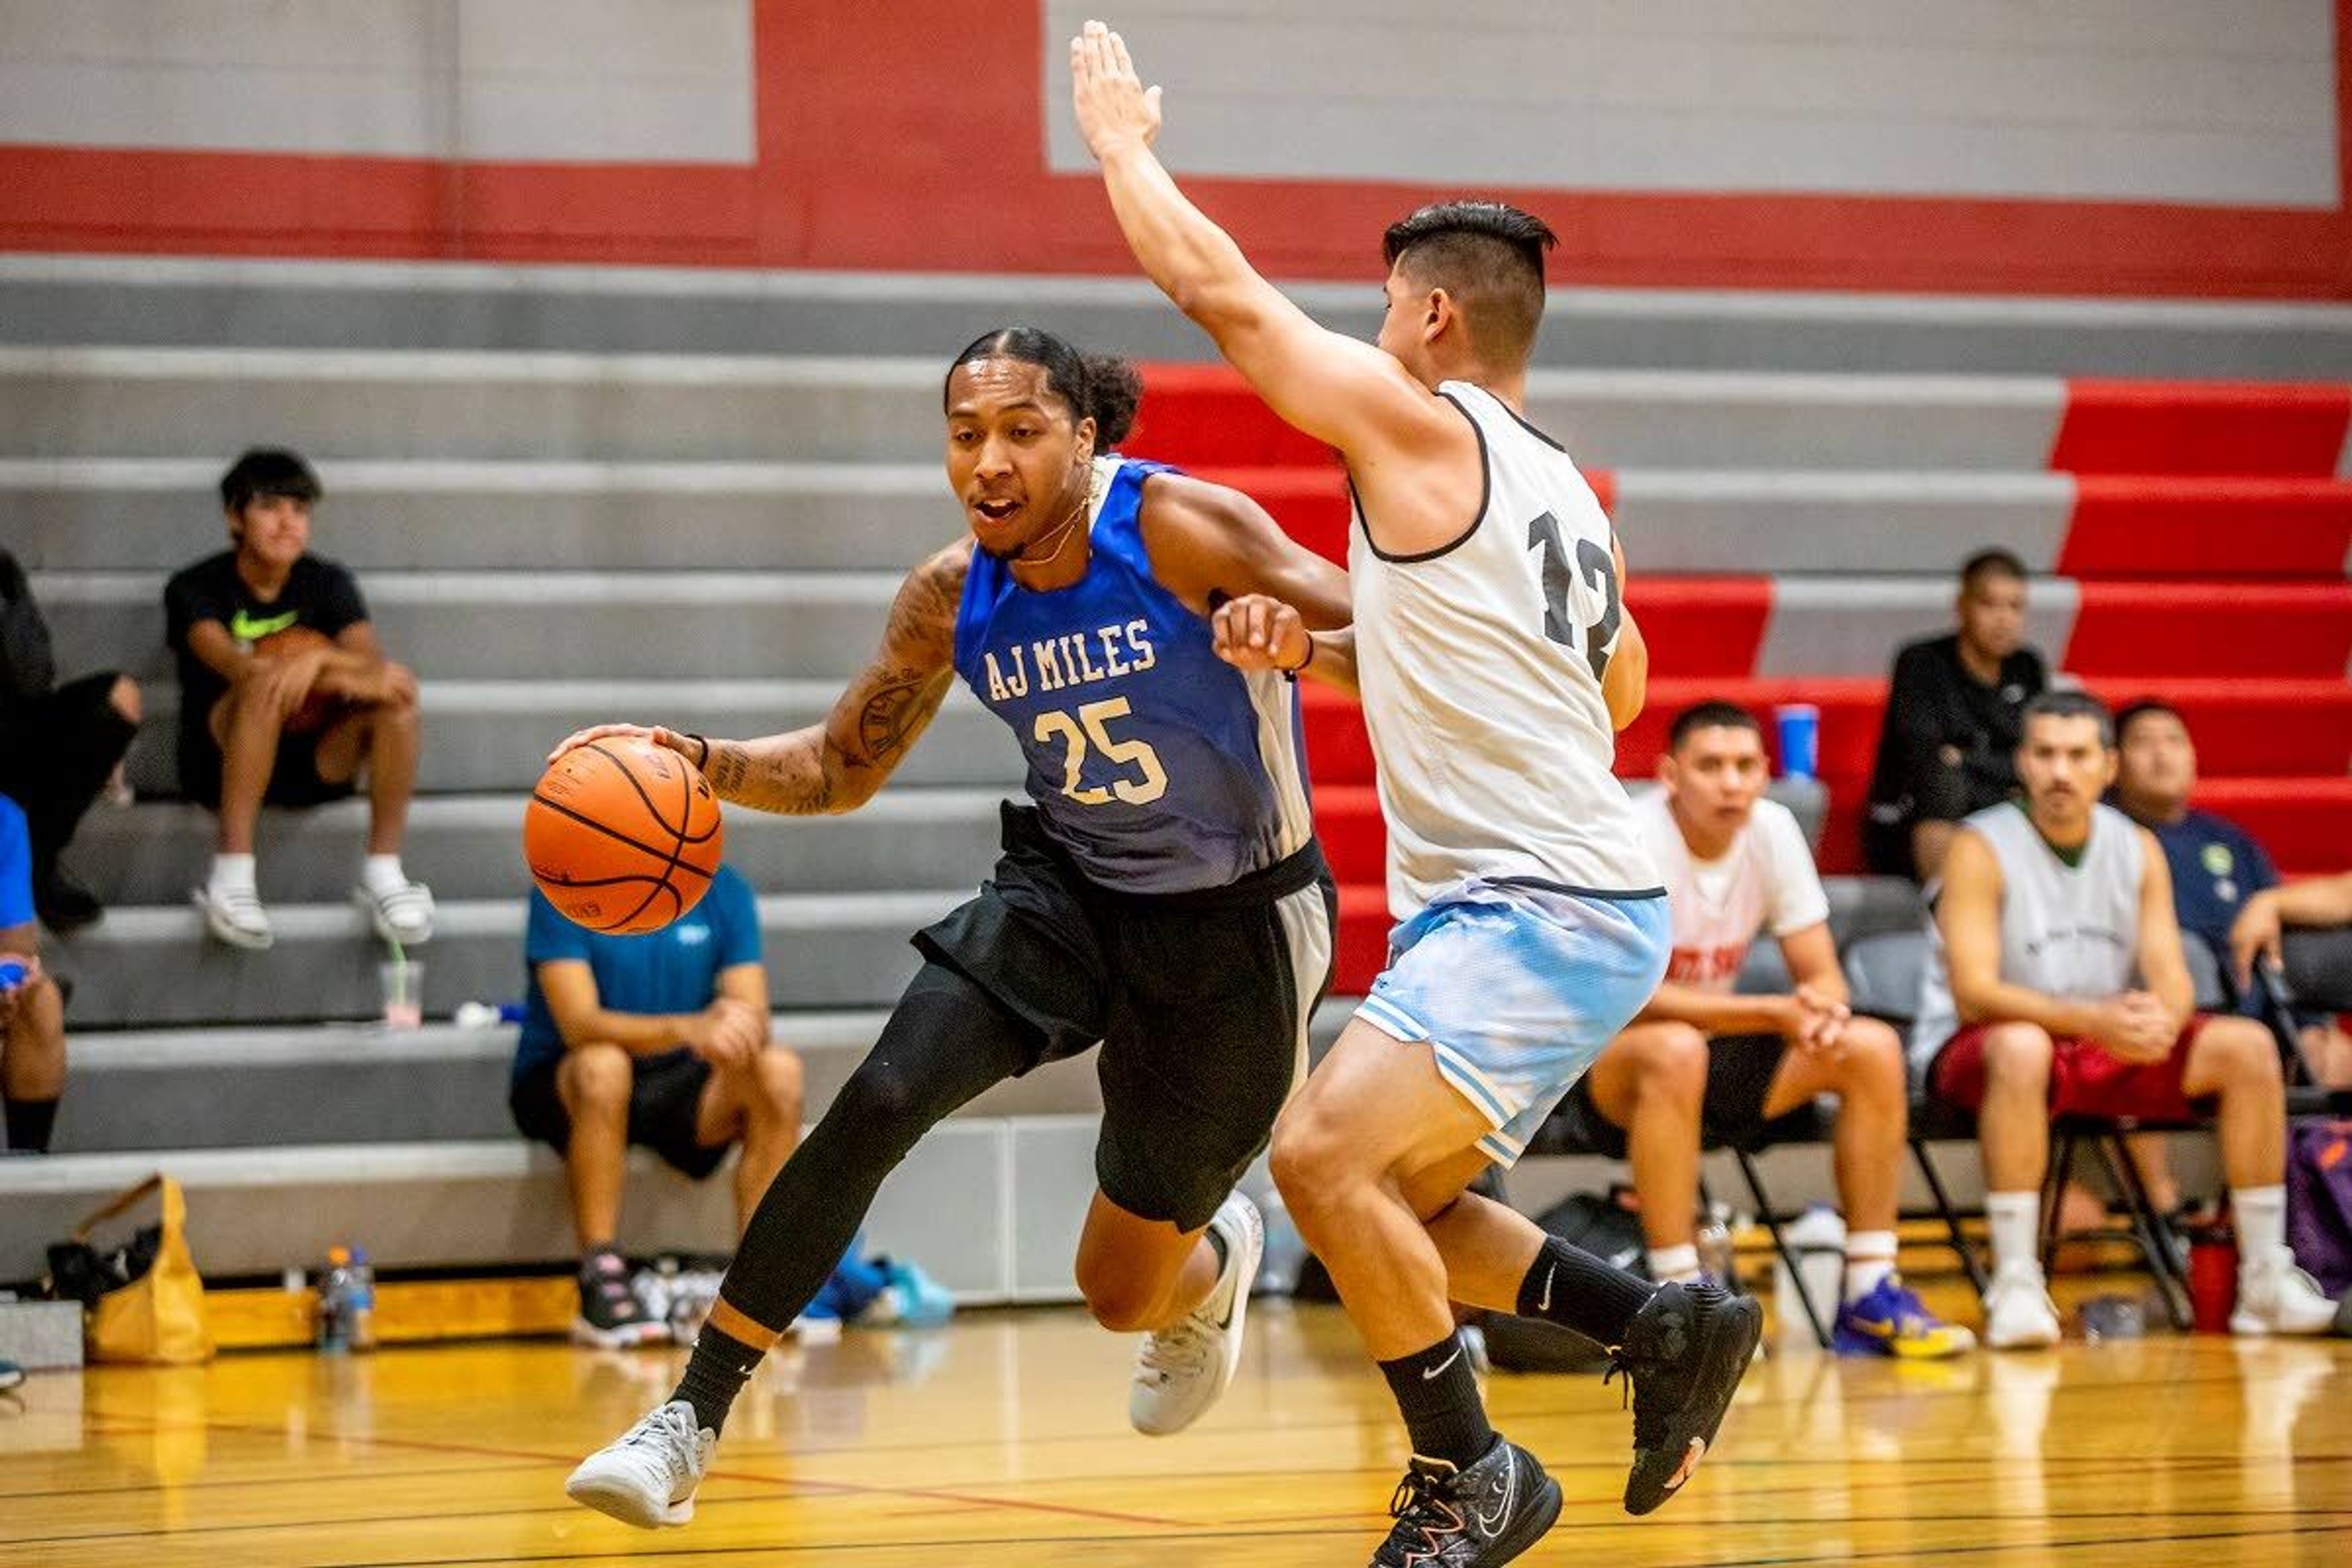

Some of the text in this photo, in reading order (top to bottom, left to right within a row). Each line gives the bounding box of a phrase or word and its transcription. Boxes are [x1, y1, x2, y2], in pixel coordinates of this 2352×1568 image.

[1527, 510, 1621, 684] 12
[984, 619, 1156, 701] AJ MILES
[1034, 696, 1168, 805] 25
